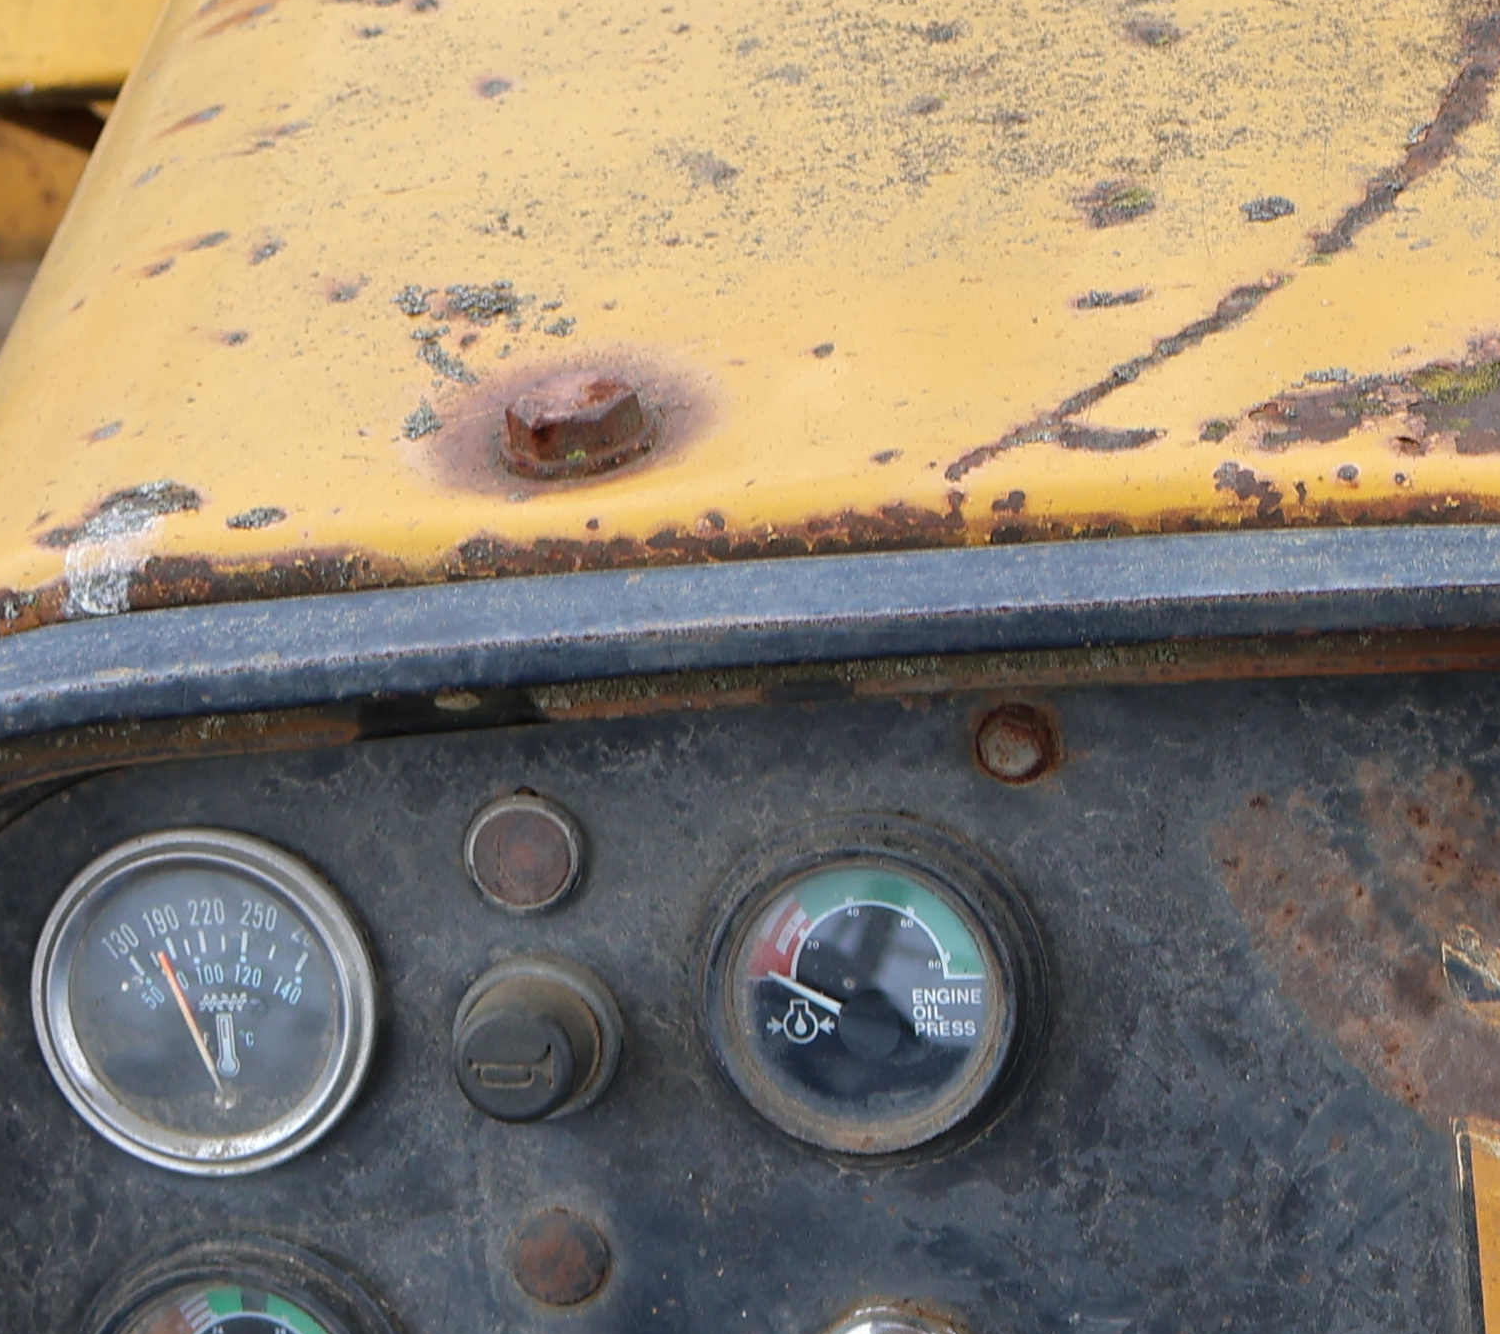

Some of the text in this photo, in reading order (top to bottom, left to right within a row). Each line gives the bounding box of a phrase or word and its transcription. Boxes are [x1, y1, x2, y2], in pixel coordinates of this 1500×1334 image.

[102, 898, 278, 959] 130 190 220 250
[806, 908, 941, 970] 20 40 60 80
[141, 985, 165, 1009] 50
[195, 964, 224, 986] 100
[235, 964, 262, 988] 120
[273, 976, 302, 1006] 140
[912, 988, 982, 1005] ENGINE
[913, 1005, 945, 1021] OIL
[914, 1021, 977, 1037] PRESS
